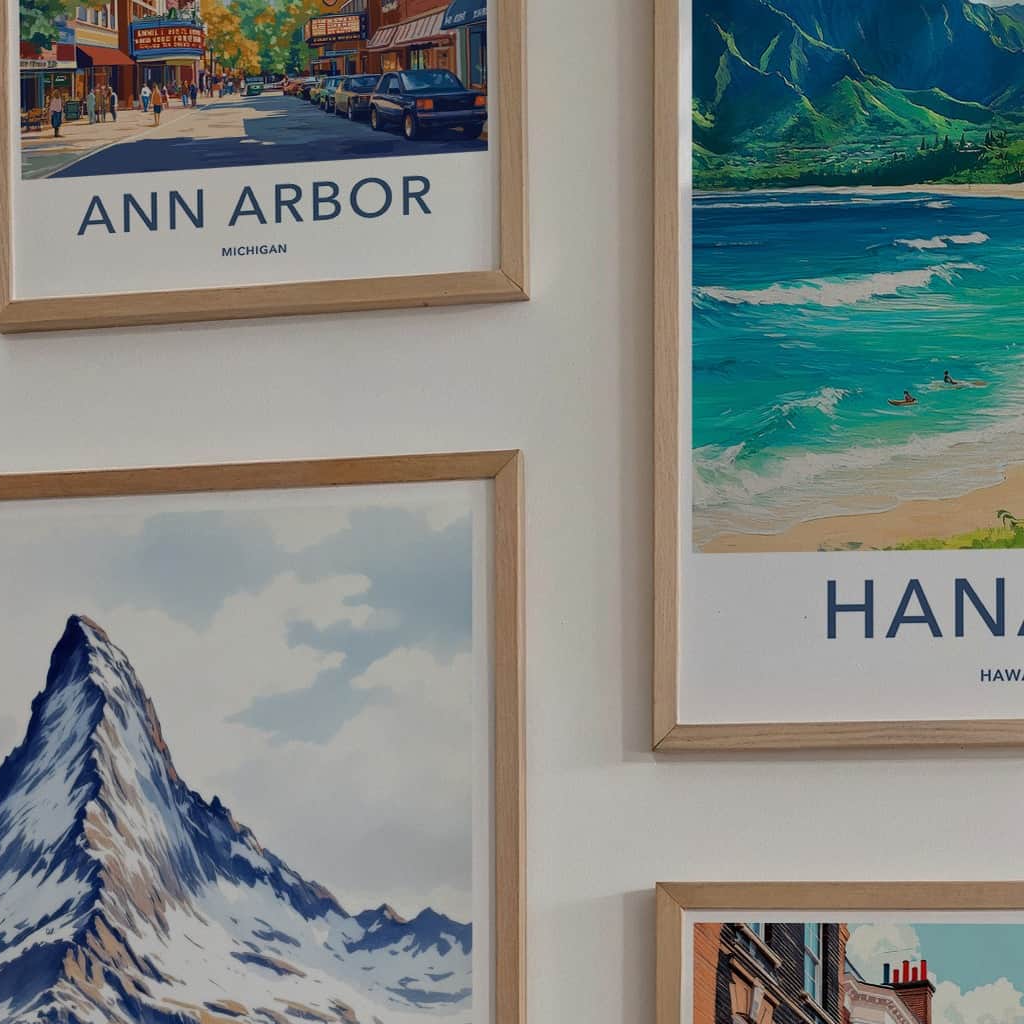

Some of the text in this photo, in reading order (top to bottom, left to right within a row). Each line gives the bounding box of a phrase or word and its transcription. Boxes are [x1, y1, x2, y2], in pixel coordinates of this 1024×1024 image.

[77, 175, 432, 236] ANN ARBOR
[221, 243, 287, 257] MICHIGAN
[826, 577, 1024, 640] HAN
